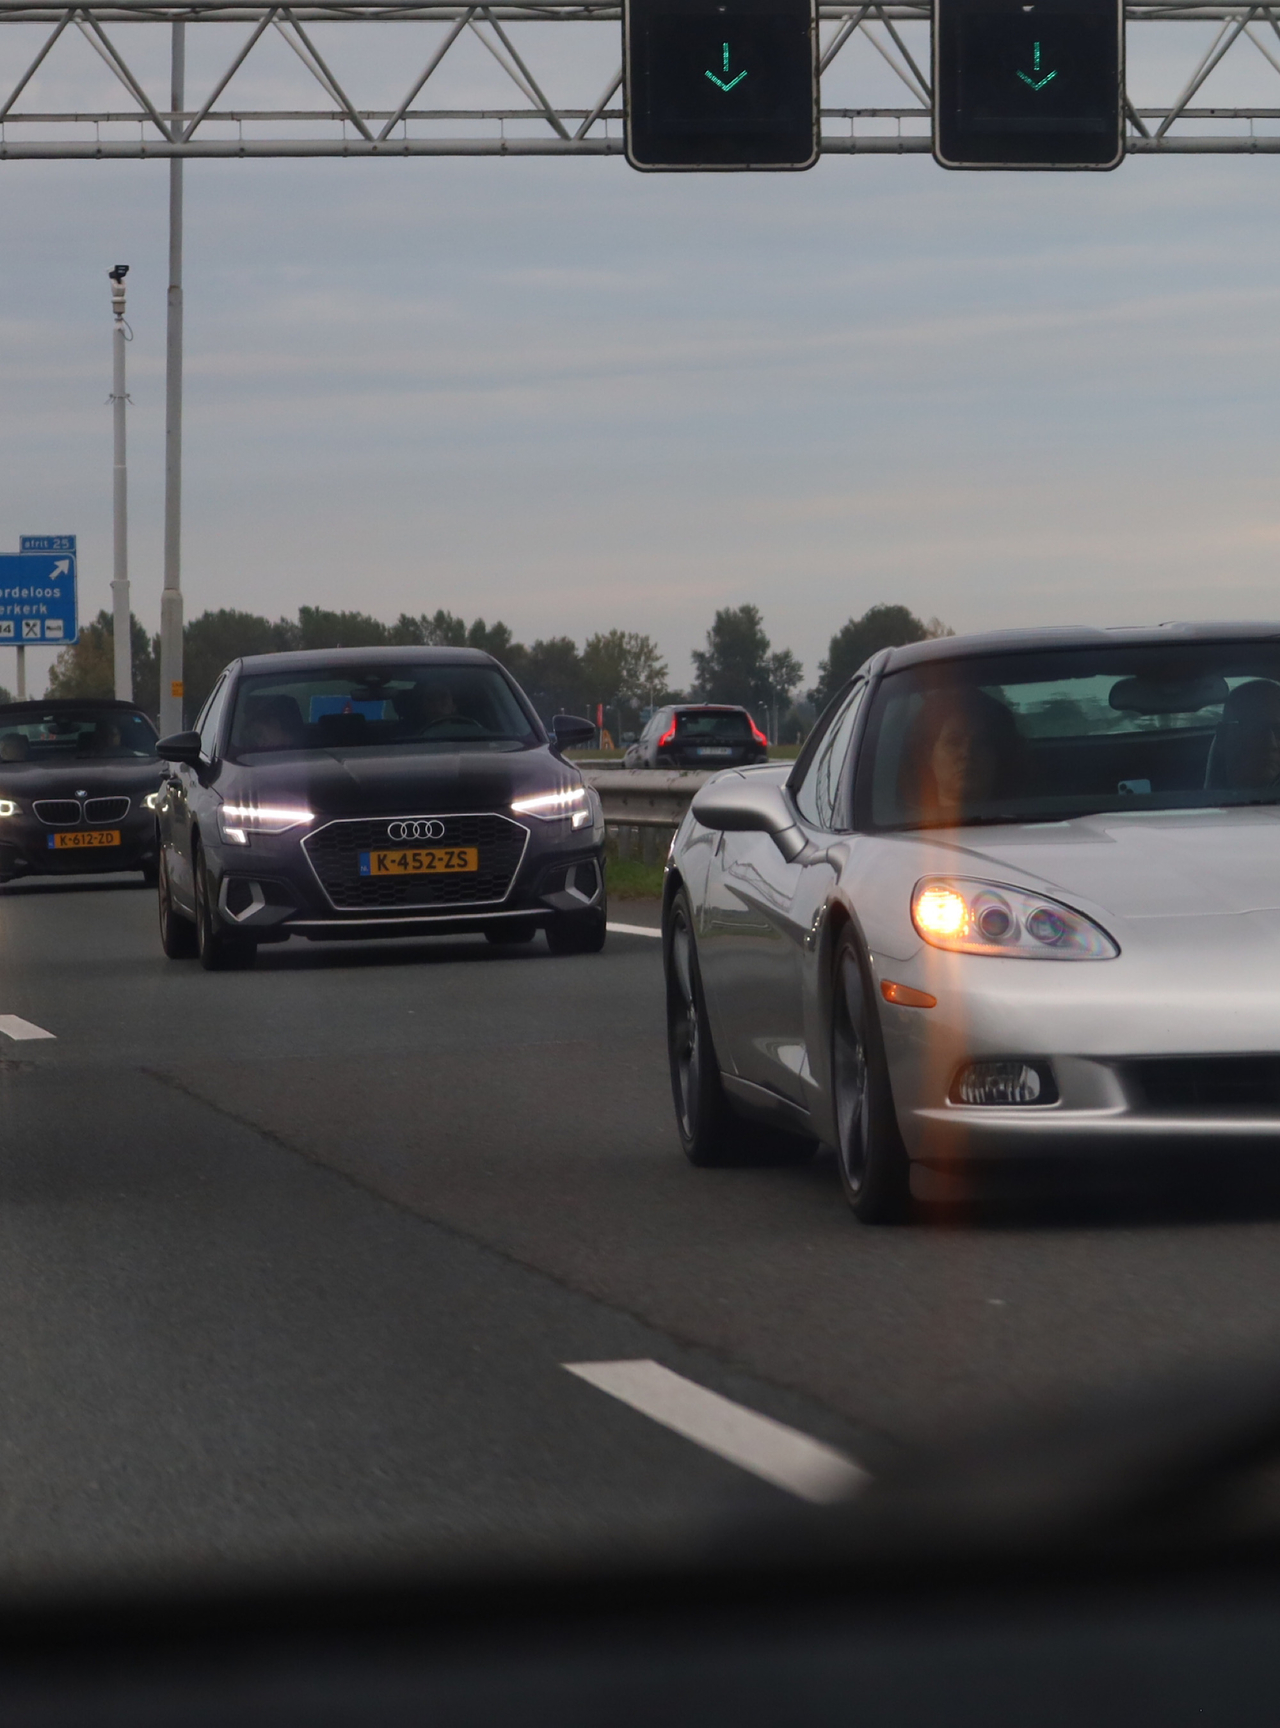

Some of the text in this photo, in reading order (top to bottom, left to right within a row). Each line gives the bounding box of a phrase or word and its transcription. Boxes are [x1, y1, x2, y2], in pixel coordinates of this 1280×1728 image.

[24, 539, 70, 549] afrit 25
[60, 832, 114, 846] K-612-ZD
[377, 851, 469, 871] K-452-ZS
